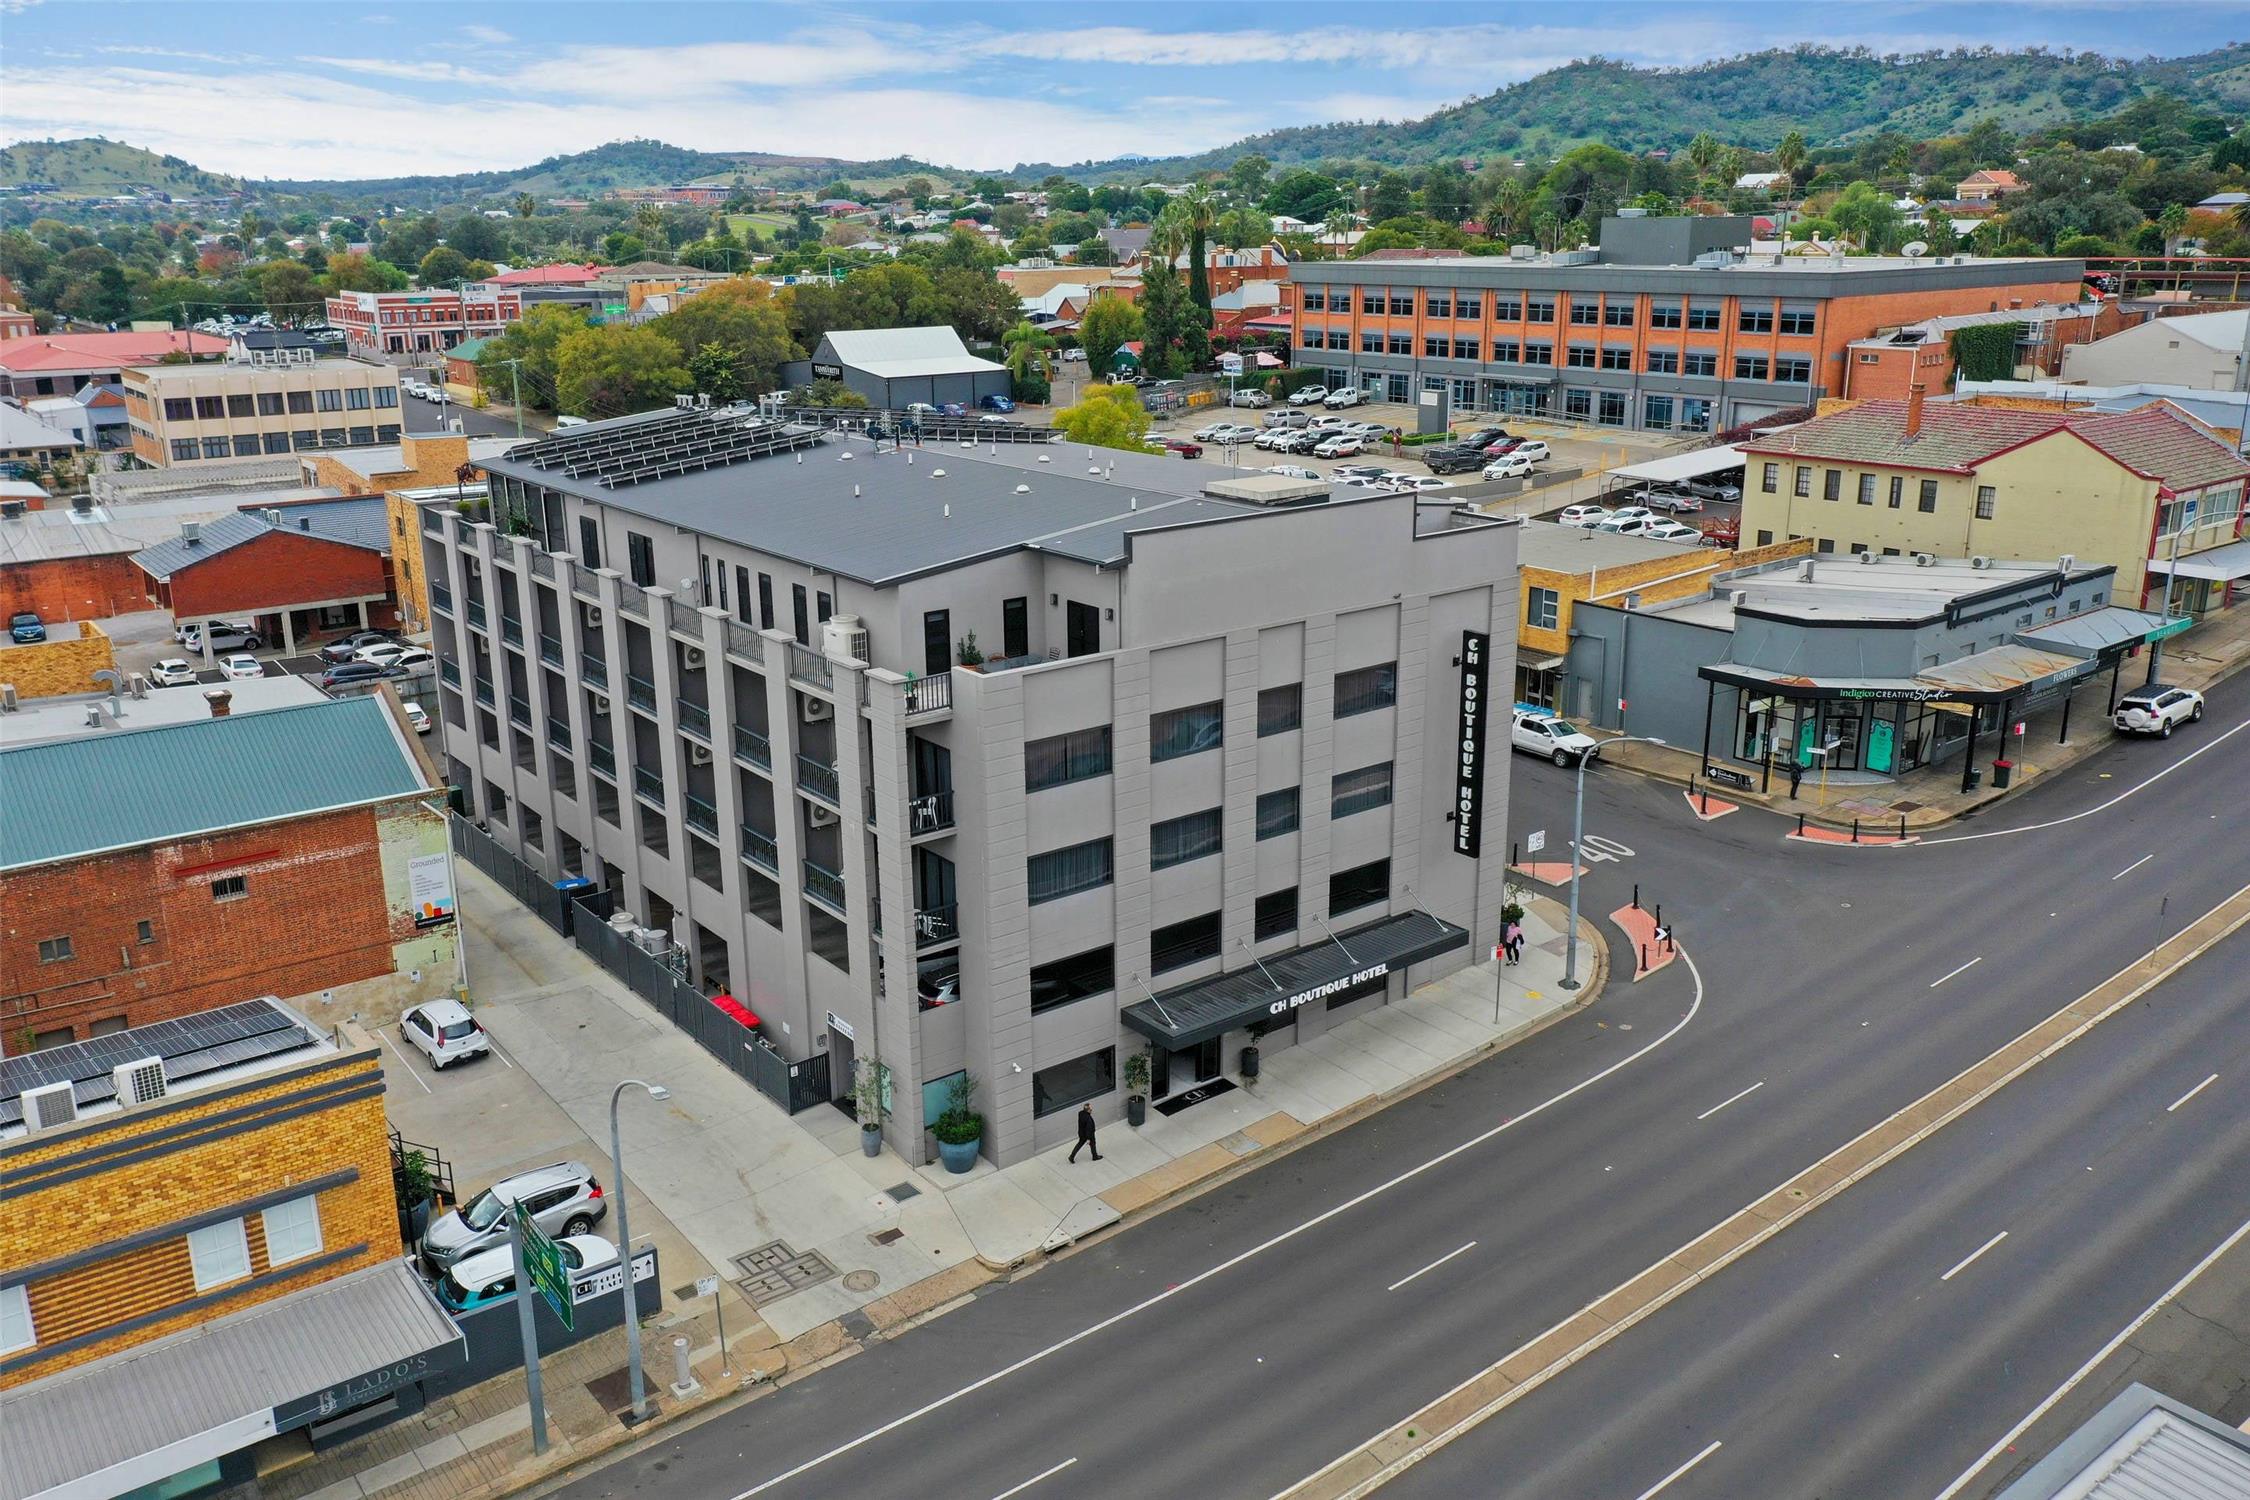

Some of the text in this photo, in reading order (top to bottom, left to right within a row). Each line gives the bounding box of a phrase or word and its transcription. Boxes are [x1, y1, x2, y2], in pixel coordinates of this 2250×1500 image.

[2052, 667, 2078, 682] FLOWERS
[1875, 690, 1914, 699] CREATIVE
[1459, 638, 1479, 850] CH BOUTIQUE HOTEL
[409, 856, 445, 869] Grounded
[1269, 963, 1389, 1014] CH BOUTIQUE HOTEL
[344, 1355, 428, 1398] LADO'S
